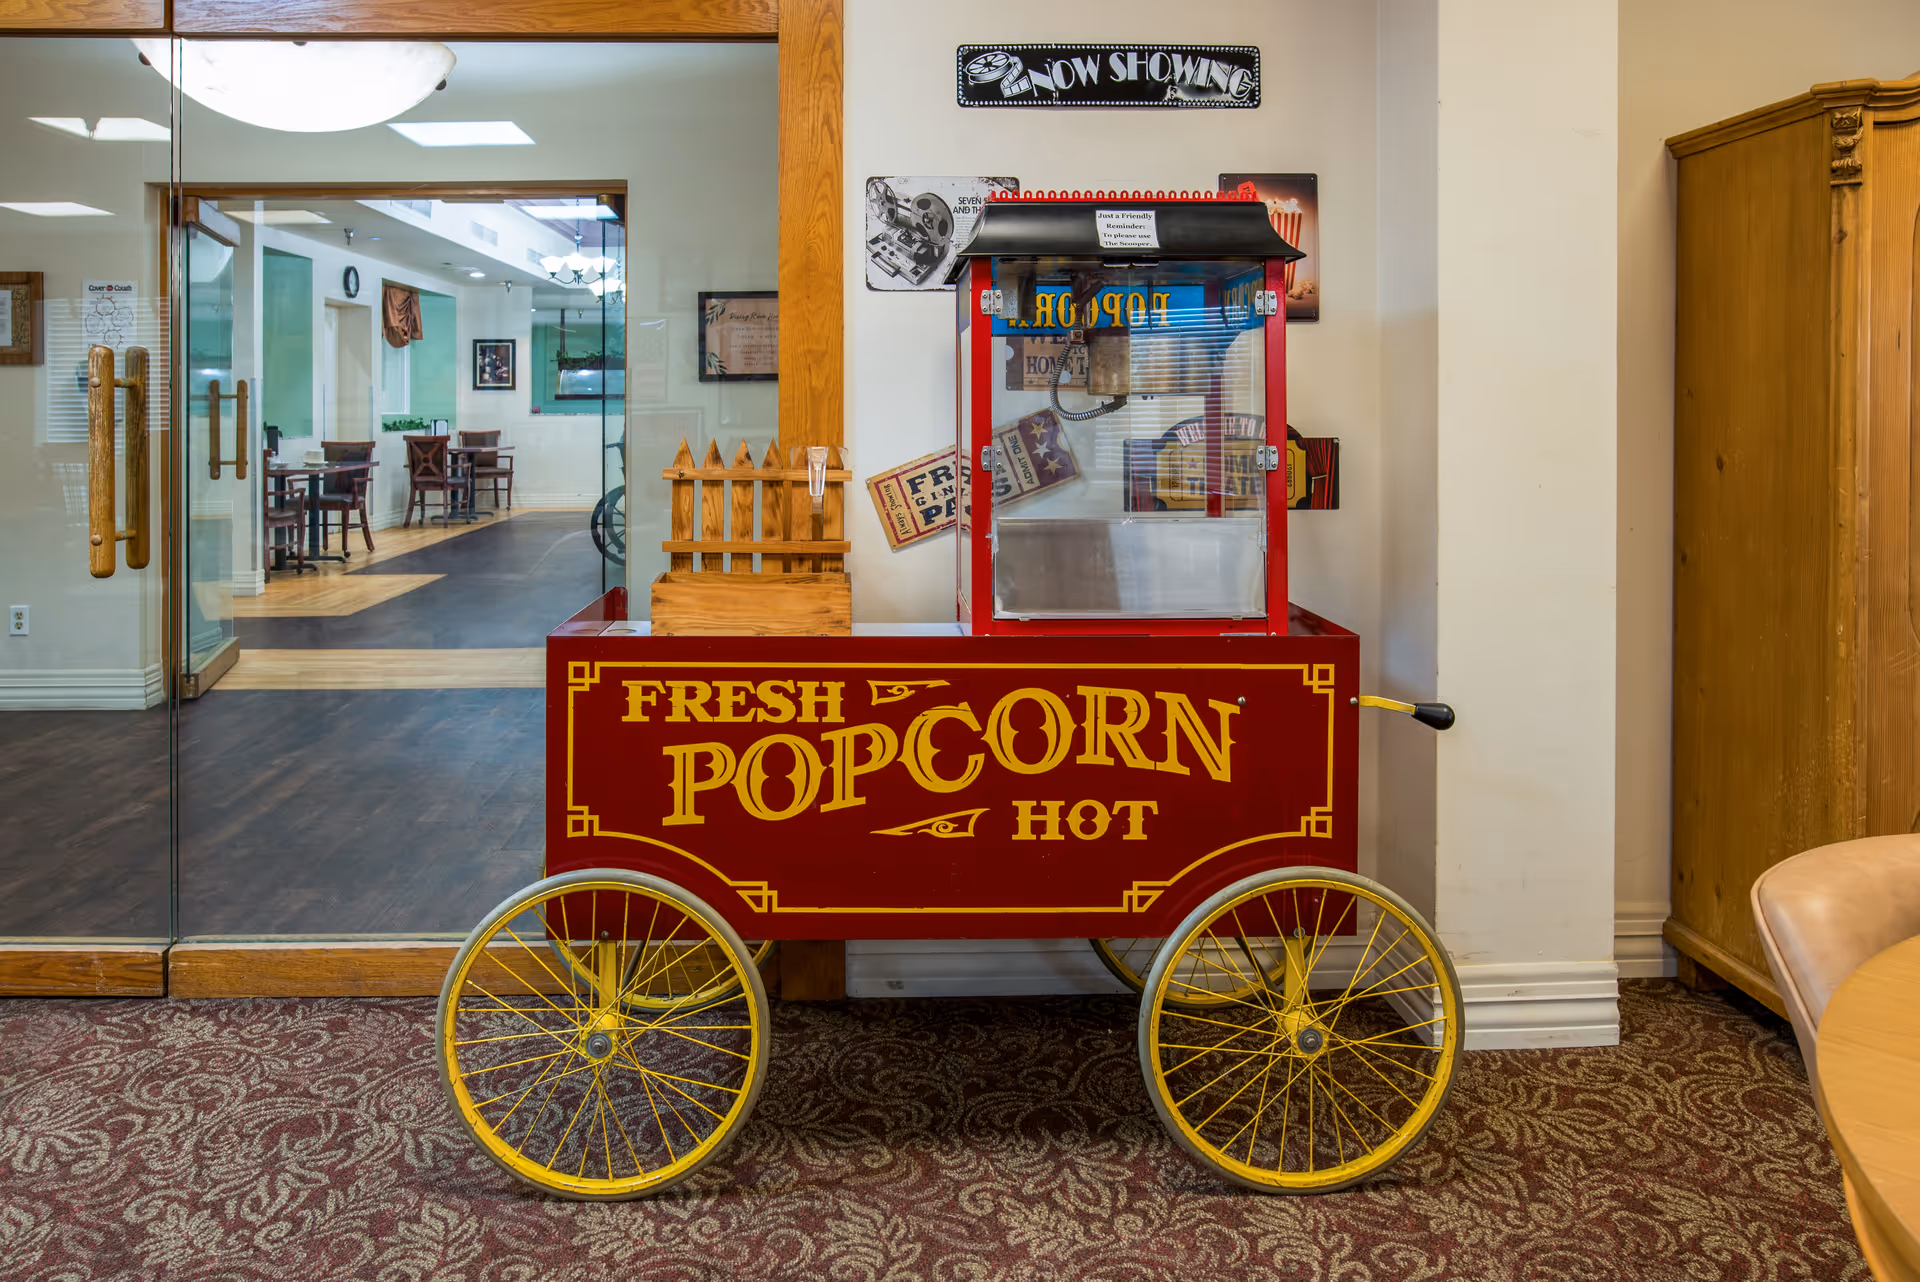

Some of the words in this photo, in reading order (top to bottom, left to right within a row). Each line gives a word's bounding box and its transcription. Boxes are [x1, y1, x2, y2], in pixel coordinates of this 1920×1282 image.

[1028, 54, 1100, 97] NOW
[1109, 51, 1253, 98] SHOWING
[953, 206, 971, 214] AND
[972, 206, 981, 214] TH
[958, 196, 982, 205] SEVEN
[88, 284, 105, 292] Cover
[1008, 434, 1023, 455] ONE
[1018, 456, 1035, 485] ADMIT
[884, 483, 902, 511] Showing
[895, 512, 913, 536] Always
[621, 680, 845, 723] FRESH
[662, 685, 1240, 826] POPCORN
[1012, 799, 1158, 841] HOT
